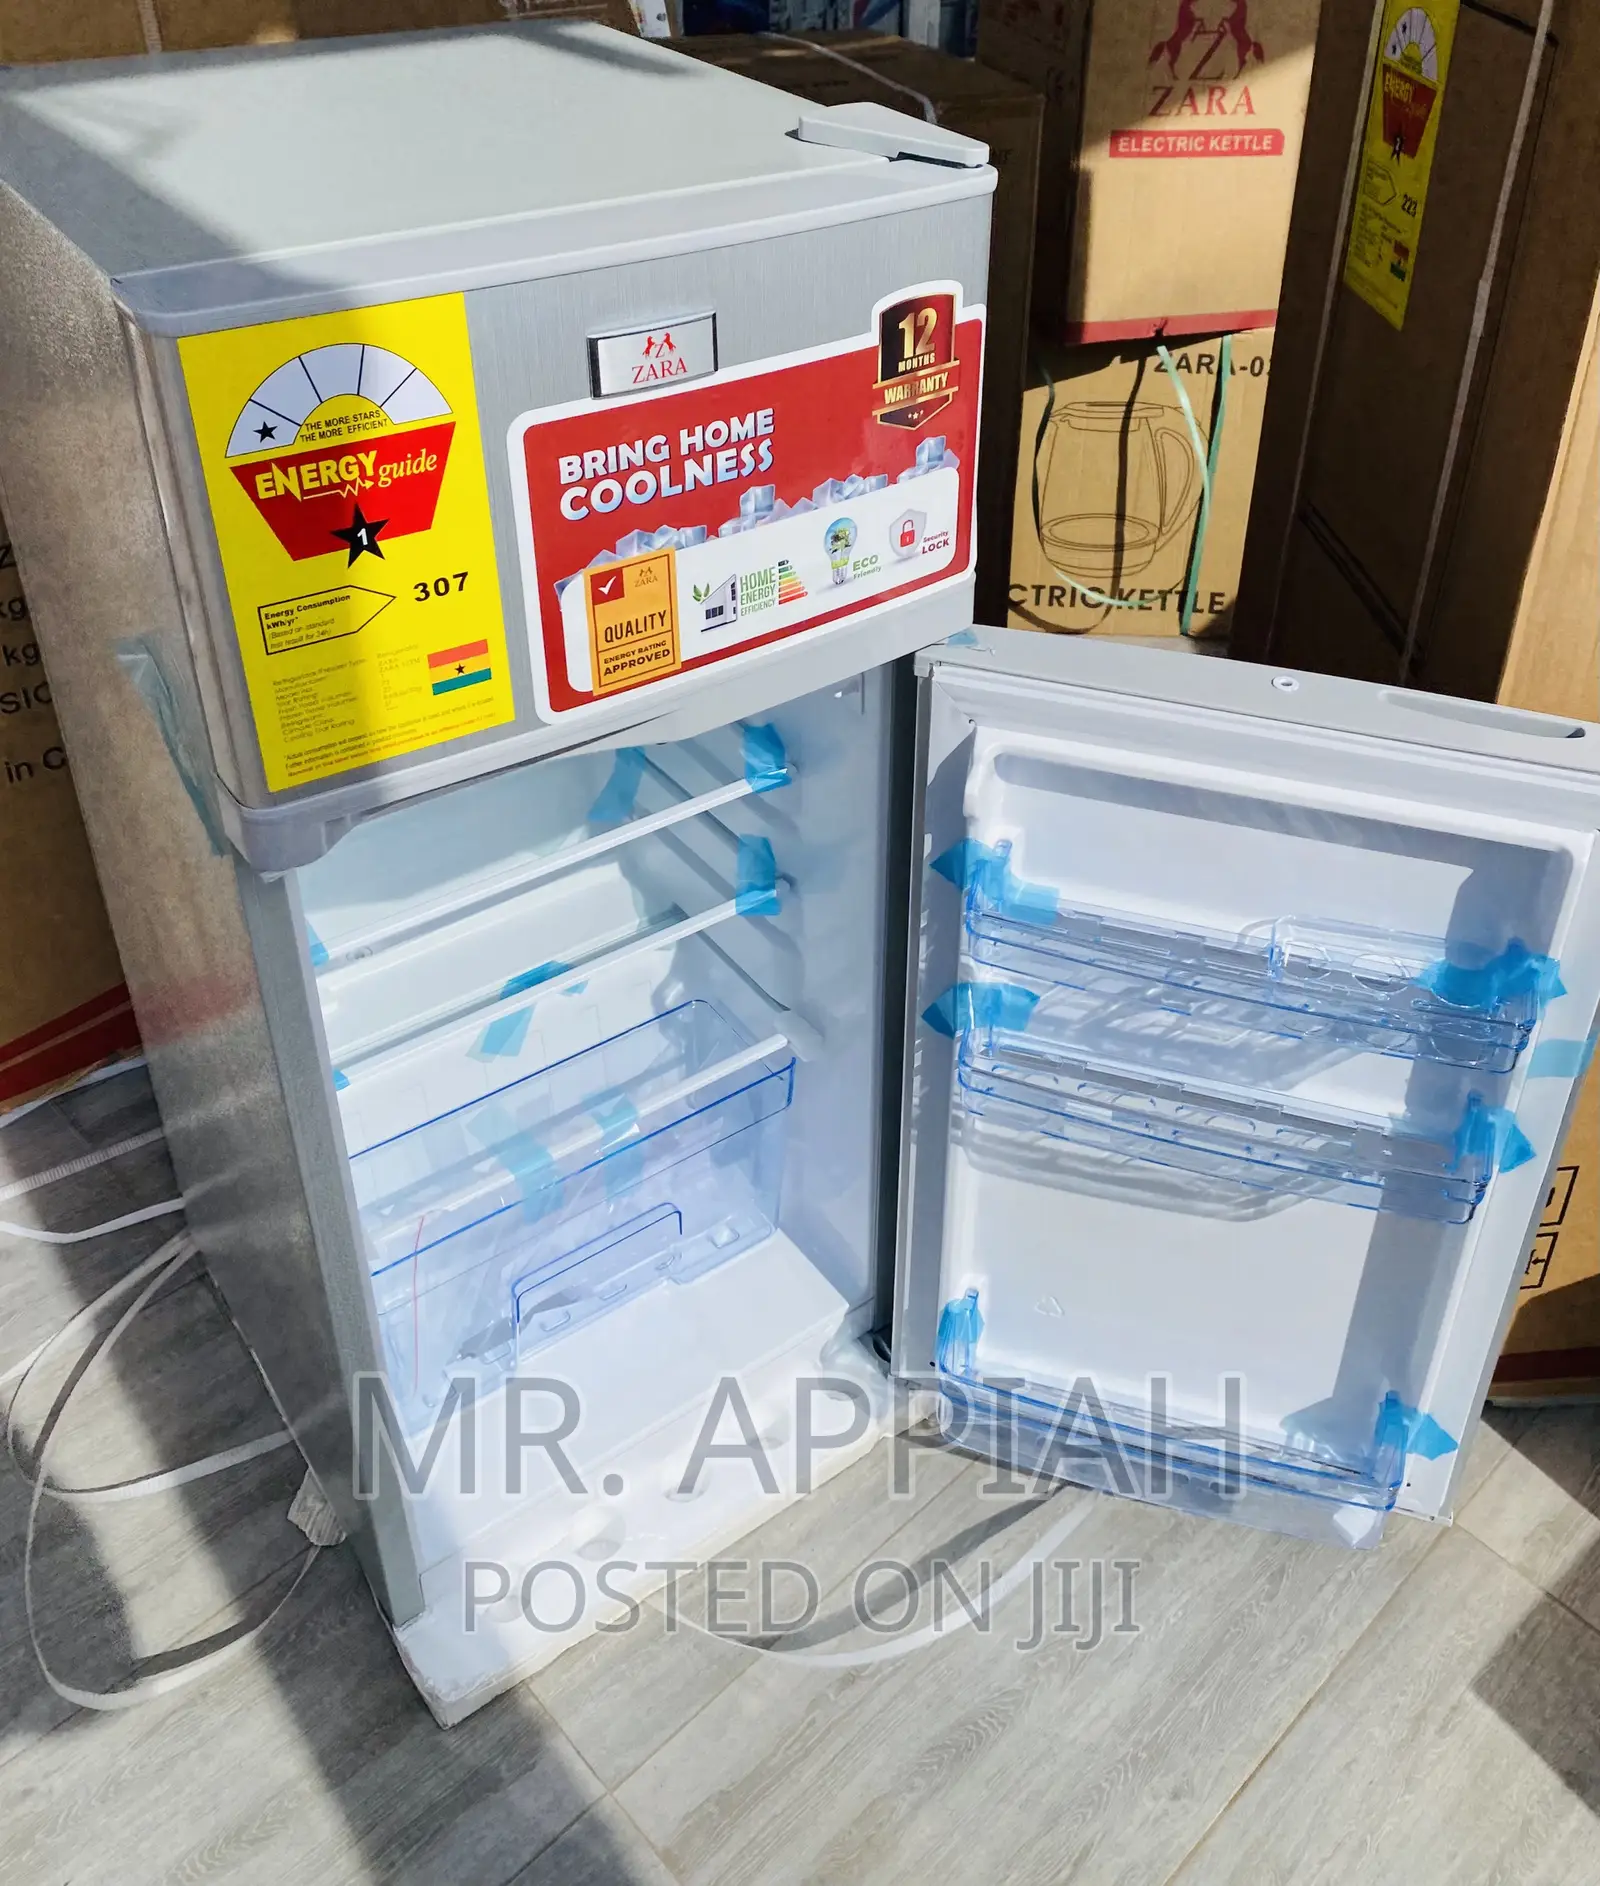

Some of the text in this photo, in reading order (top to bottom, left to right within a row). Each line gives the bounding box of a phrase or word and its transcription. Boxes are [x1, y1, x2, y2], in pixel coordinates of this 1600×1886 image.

[1149, 85, 1256, 117] ZARA
[1118, 135, 1274, 153] ELECTRIC KETTLE
[898, 307, 938, 359] 12
[631, 357, 688, 384] ZARA
[898, 352, 936, 373] MONTHS
[884, 371, 949, 405] WARRANTY
[300, 418, 388, 443] THE MORE EFFICIENT
[305, 410, 381, 432] THE MORE STARS
[558, 408, 775, 485] BRING HOME
[255, 448, 437, 502] ENERGY guide
[559, 438, 774, 521] COOLNESS
[357, 527, 368, 545] 1
[921, 537, 950, 555] LOCK
[923, 530, 949, 543] Security
[852, 554, 879, 572] ECO
[853, 566, 882, 580] Friendly
[413, 571, 469, 602] 307
[634, 575, 659, 588] ZARA
[740, 566, 777, 591] HOME
[264, 594, 351, 620] Energy Consumption
[740, 586, 776, 606] ENERGY
[740, 598, 776, 617] EFFICIENCY
[604, 609, 667, 644] QUALITY
[1, 642, 40, 667] kg
[603, 640, 667, 664] ENERGY RATING
[603, 648, 671, 677] APPROVED
[4, 760, 34, 784] in
